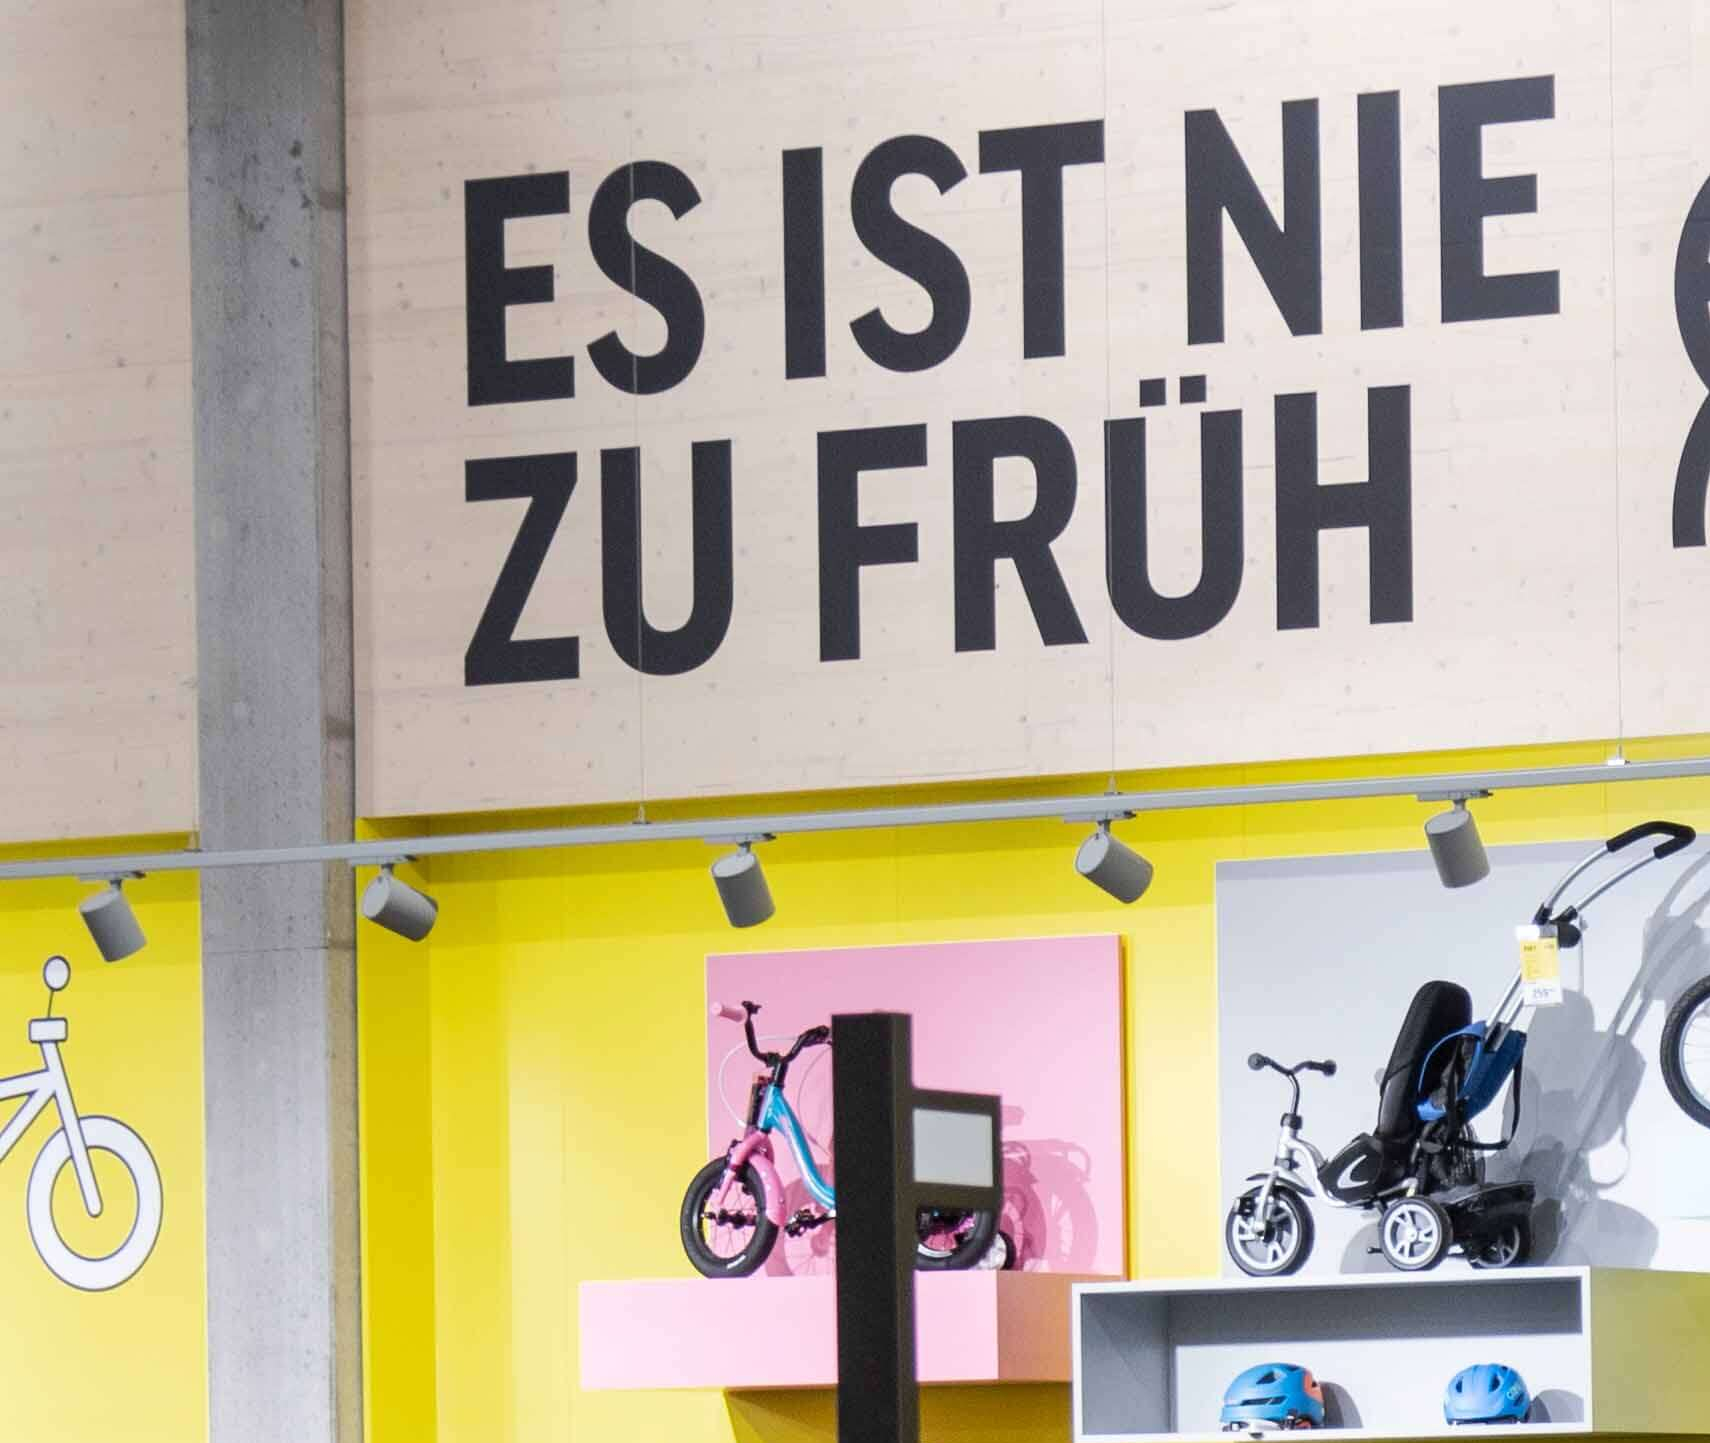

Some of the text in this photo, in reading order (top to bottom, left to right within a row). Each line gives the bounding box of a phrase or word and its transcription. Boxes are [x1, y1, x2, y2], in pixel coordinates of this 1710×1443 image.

[465, 74, 1561, 406] ES IST NIE
[465, 373, 1414, 687] ZU FRÜH
